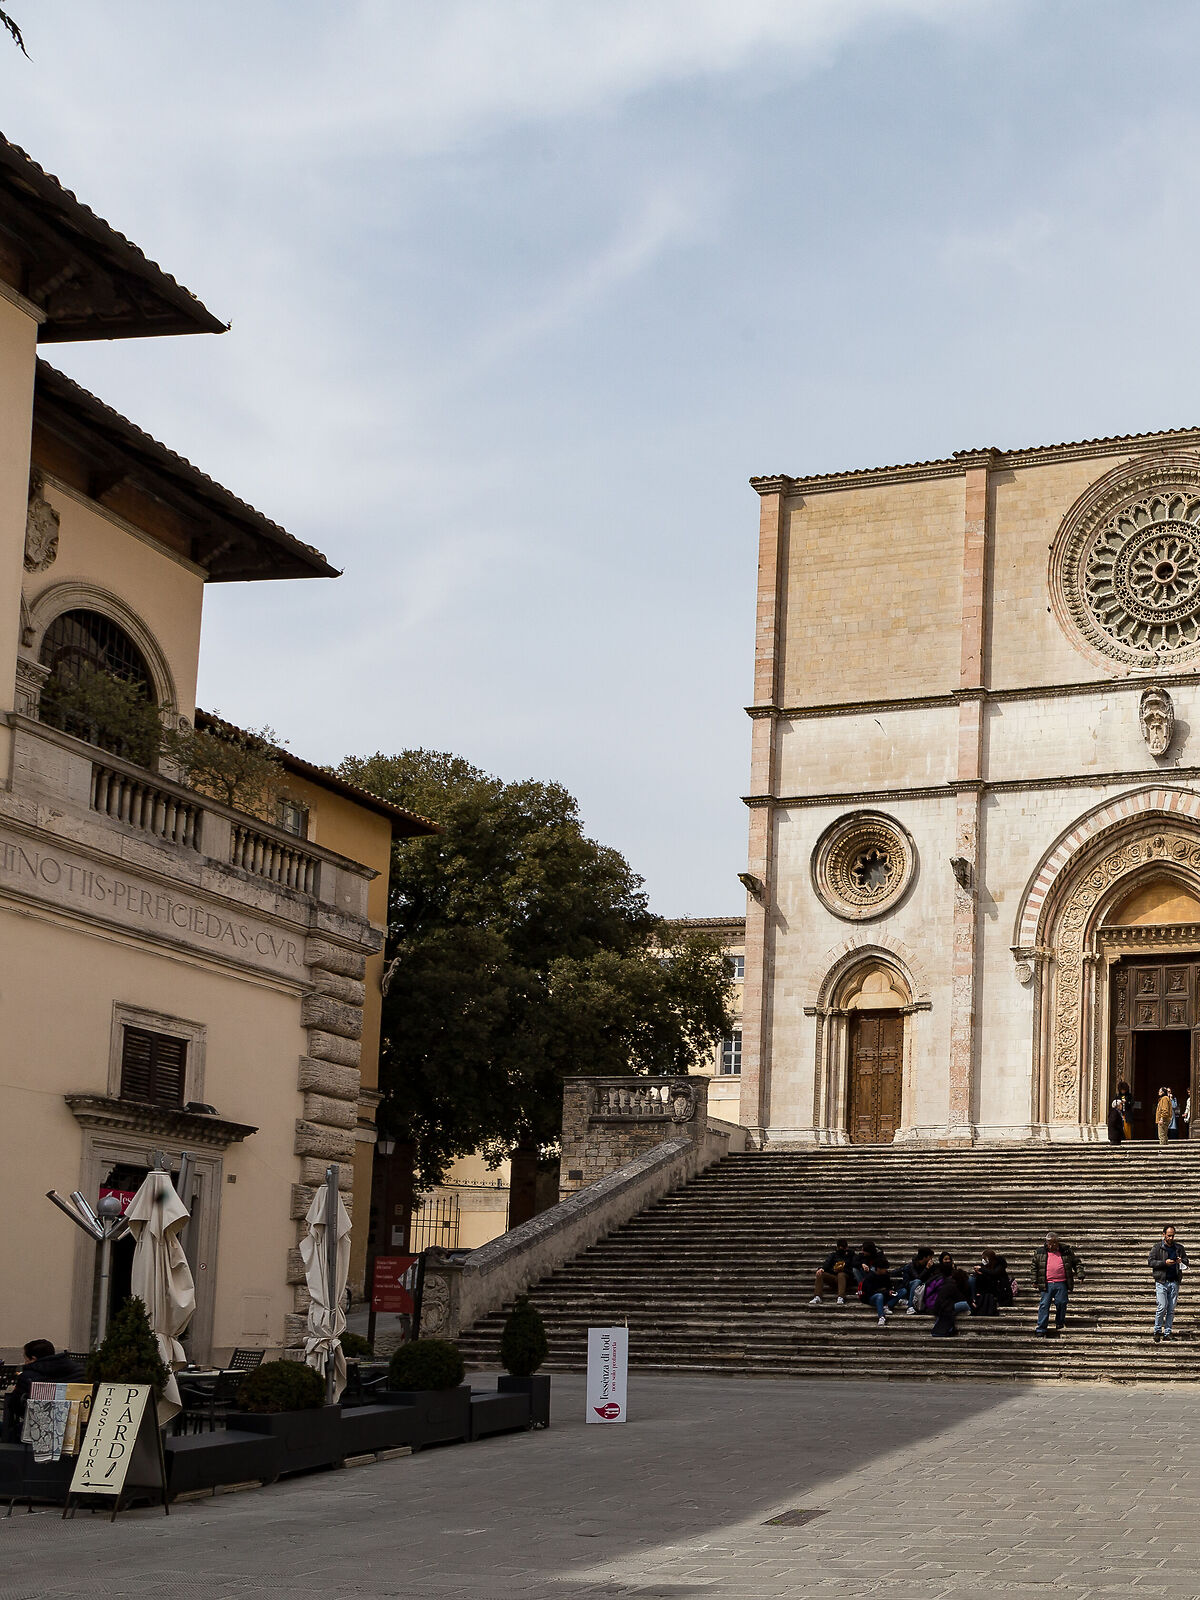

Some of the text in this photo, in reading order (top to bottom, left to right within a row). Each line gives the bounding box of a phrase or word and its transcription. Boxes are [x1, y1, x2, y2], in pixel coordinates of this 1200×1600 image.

[601, 1334, 610, 1351] todi
[601, 1354, 610, 1362] di
[81, 1387, 116, 1478] TESSITURA
